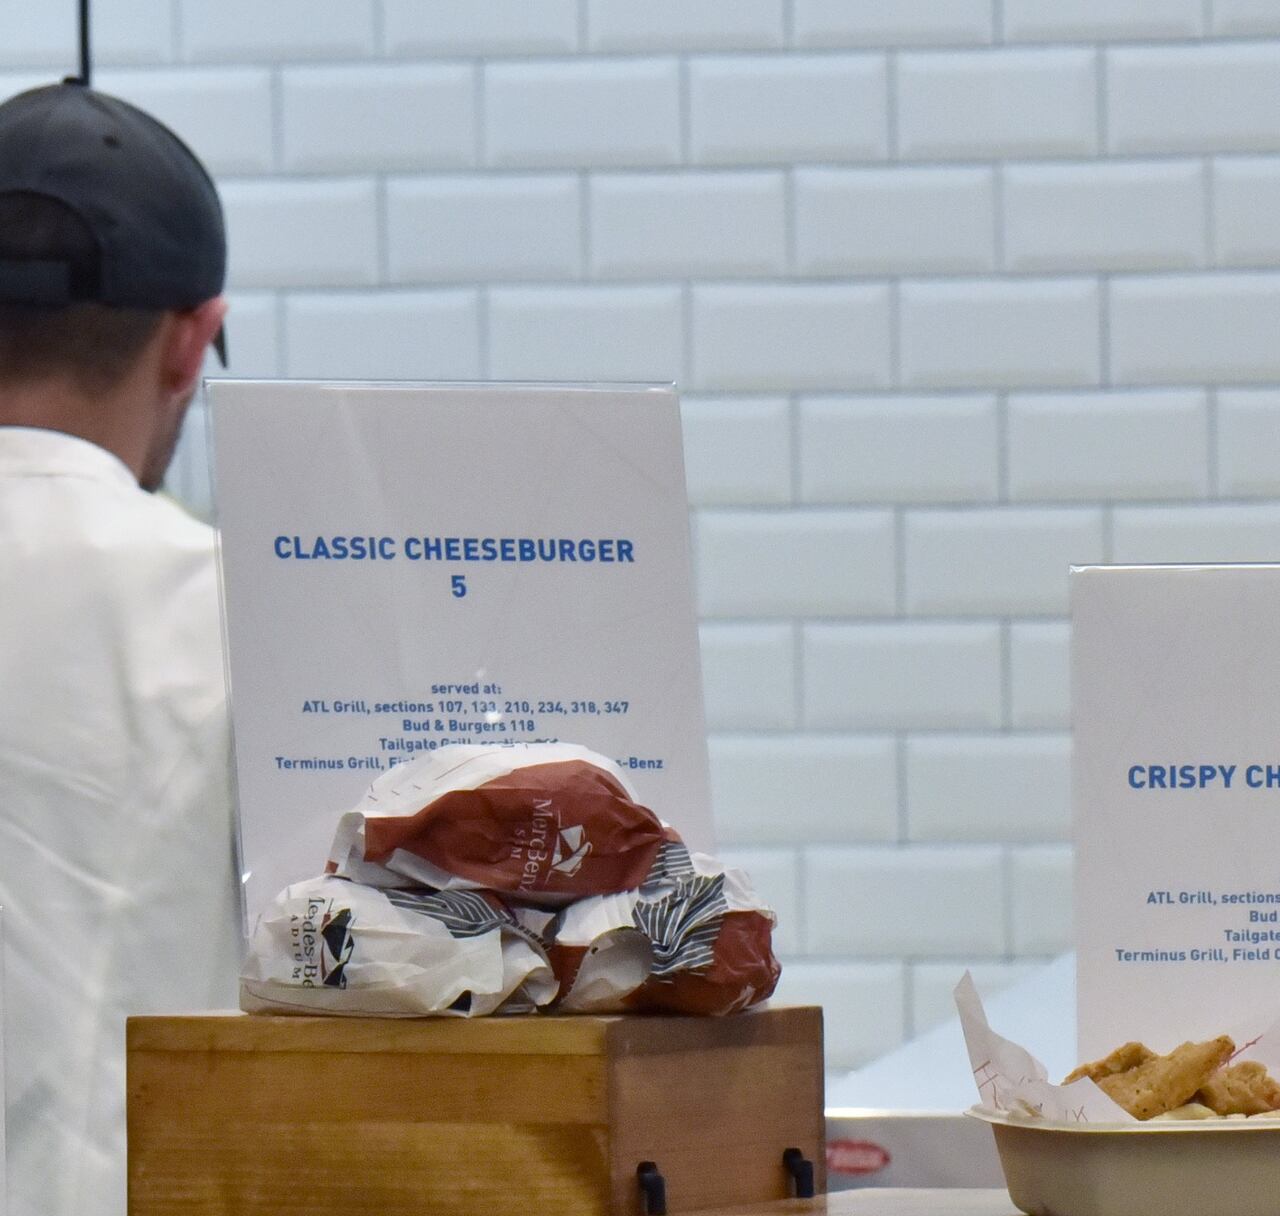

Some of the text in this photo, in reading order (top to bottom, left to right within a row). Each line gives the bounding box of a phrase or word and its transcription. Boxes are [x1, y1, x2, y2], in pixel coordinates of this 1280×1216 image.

[273, 535, 635, 563] CLASSIC CHEESEBURGER
[450, 574, 467, 599] 5
[431, 682, 502, 695] served at:
[302, 700, 330, 713] ATL
[333, 700, 371, 715] Grill,
[374, 700, 434, 713] sections
[438, 700, 468, 715] 107,
[504, 700, 535, 715] 210,
[537, 701, 568, 715] 234,
[571, 701, 601, 715] 318,
[604, 701, 629, 714] 347
[402, 718, 536, 735] Bud & Burgers 118
[378, 737, 438, 753] Tailgate
[275, 756, 344, 770] Terminus
[347, 756, 385, 771] Grill,
[1128, 764, 1237, 790] CRISPY
[1146, 891, 1176, 905] ATL
[1178, 891, 1217, 906] Grill,
[1249, 910, 1278, 923] Bud
[1115, 948, 1187, 962] Terminus
[1189, 948, 1229, 963] Grill,
[1232, 948, 1270, 961] Field
